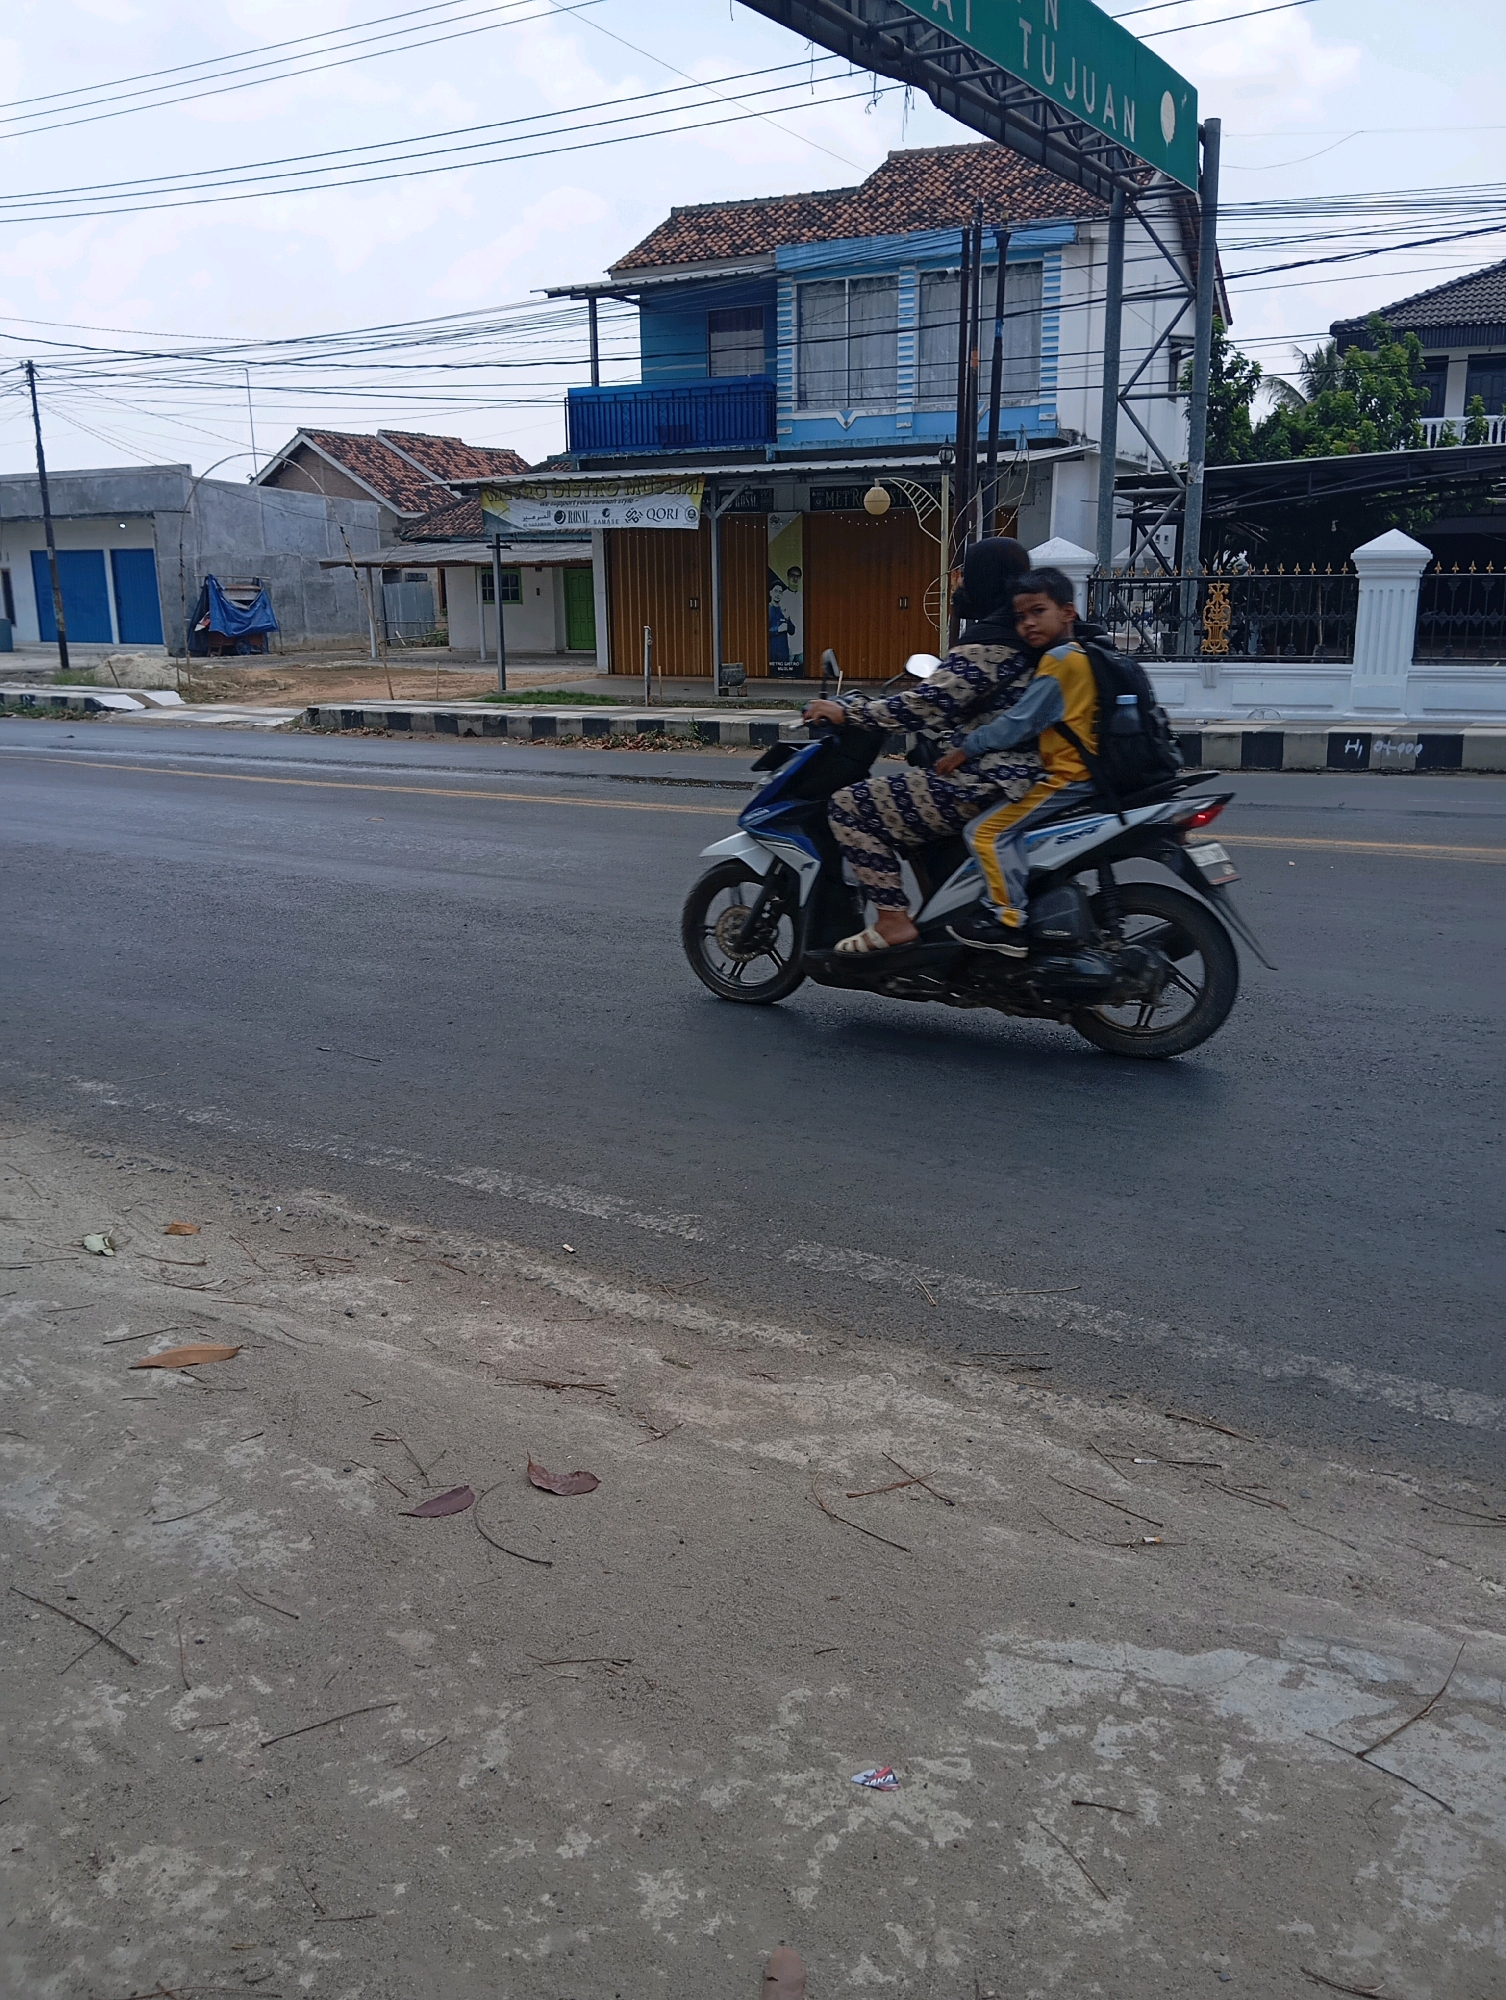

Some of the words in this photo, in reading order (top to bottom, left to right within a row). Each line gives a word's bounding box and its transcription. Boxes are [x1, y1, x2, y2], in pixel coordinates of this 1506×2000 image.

[1019, 17, 1136, 143] TUJUAN
[552, 481, 620, 498] DISTRO
[646, 507, 679, 523] QORI
